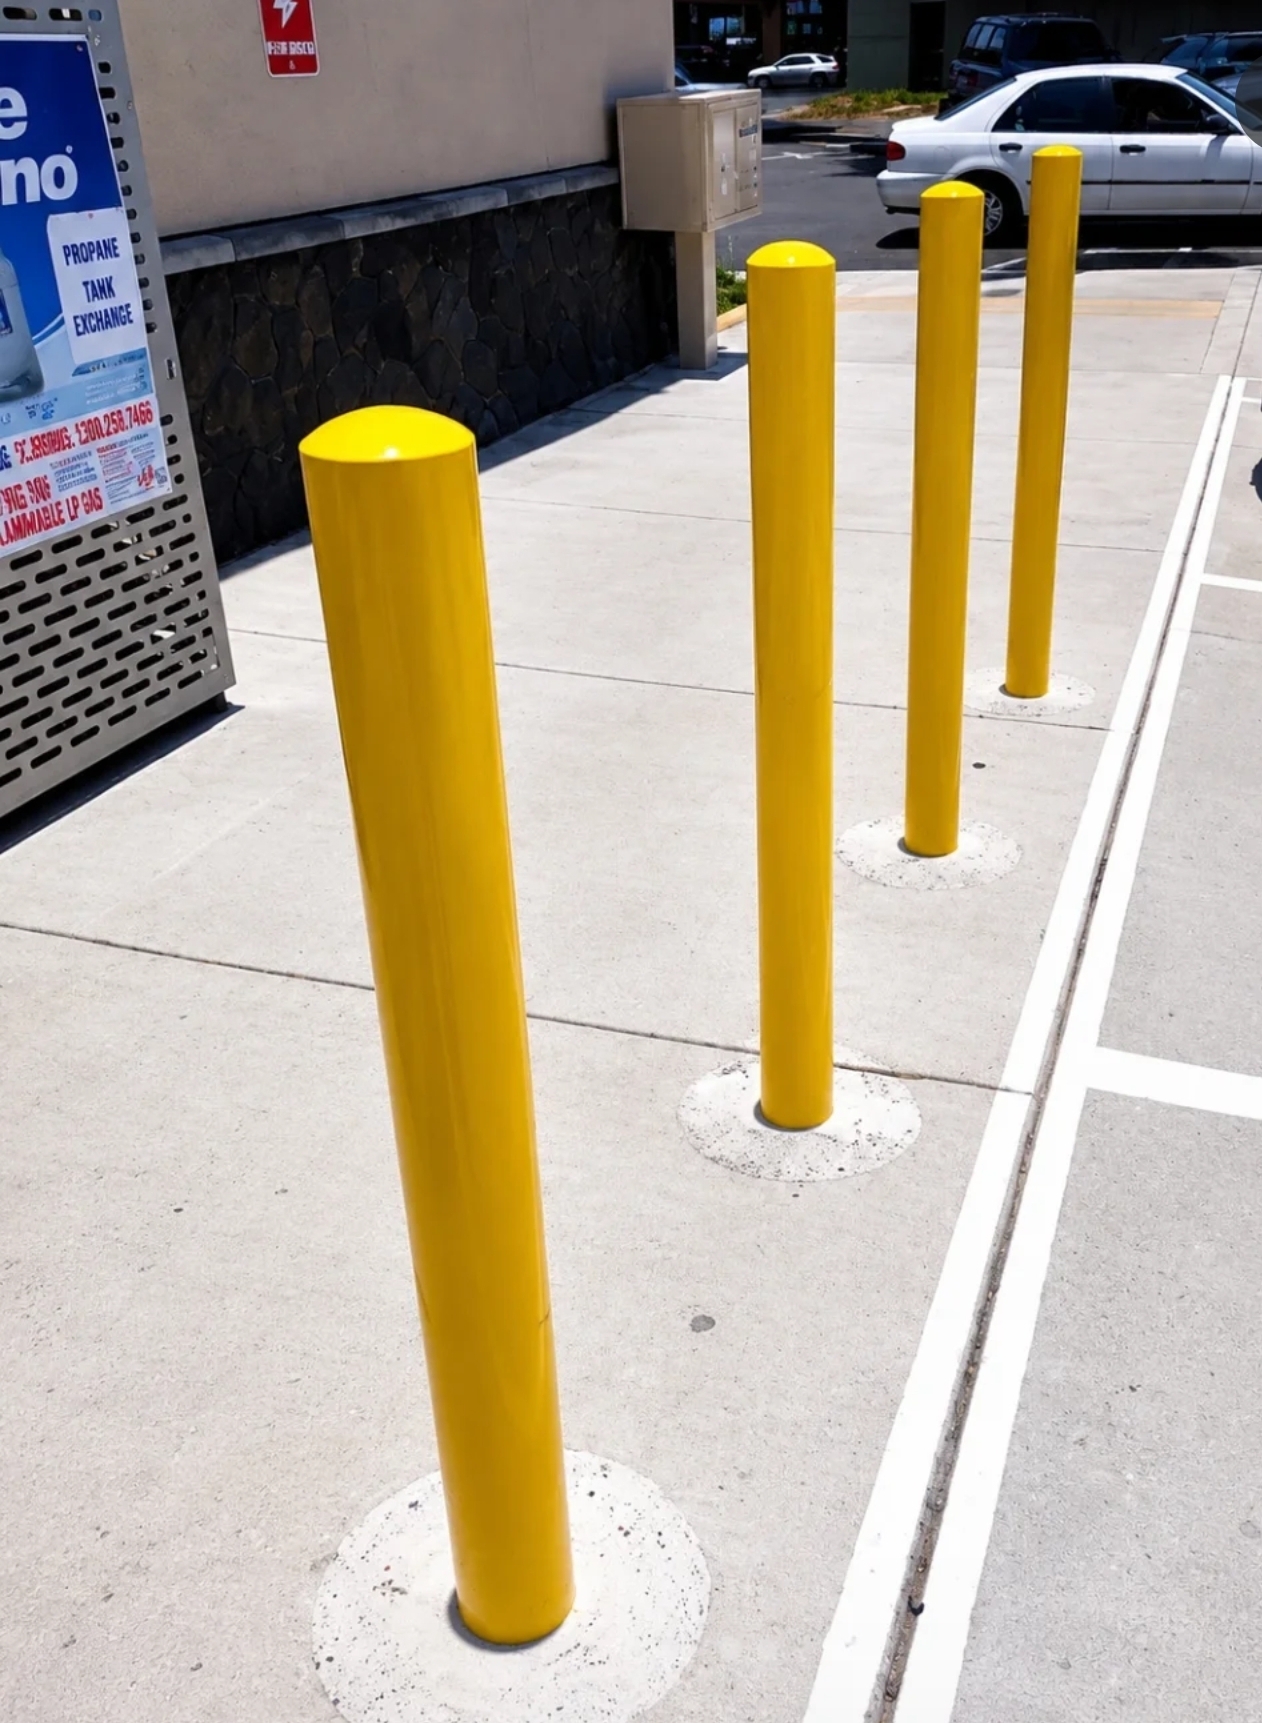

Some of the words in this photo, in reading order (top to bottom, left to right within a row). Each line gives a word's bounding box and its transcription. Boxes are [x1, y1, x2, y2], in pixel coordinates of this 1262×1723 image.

[62, 237, 120, 266] PROPANE
[82, 275, 116, 303] TANK
[73, 303, 134, 337] EXCHANGE
[66, 495, 79, 521] LP
[81, 487, 103, 514] GAS
